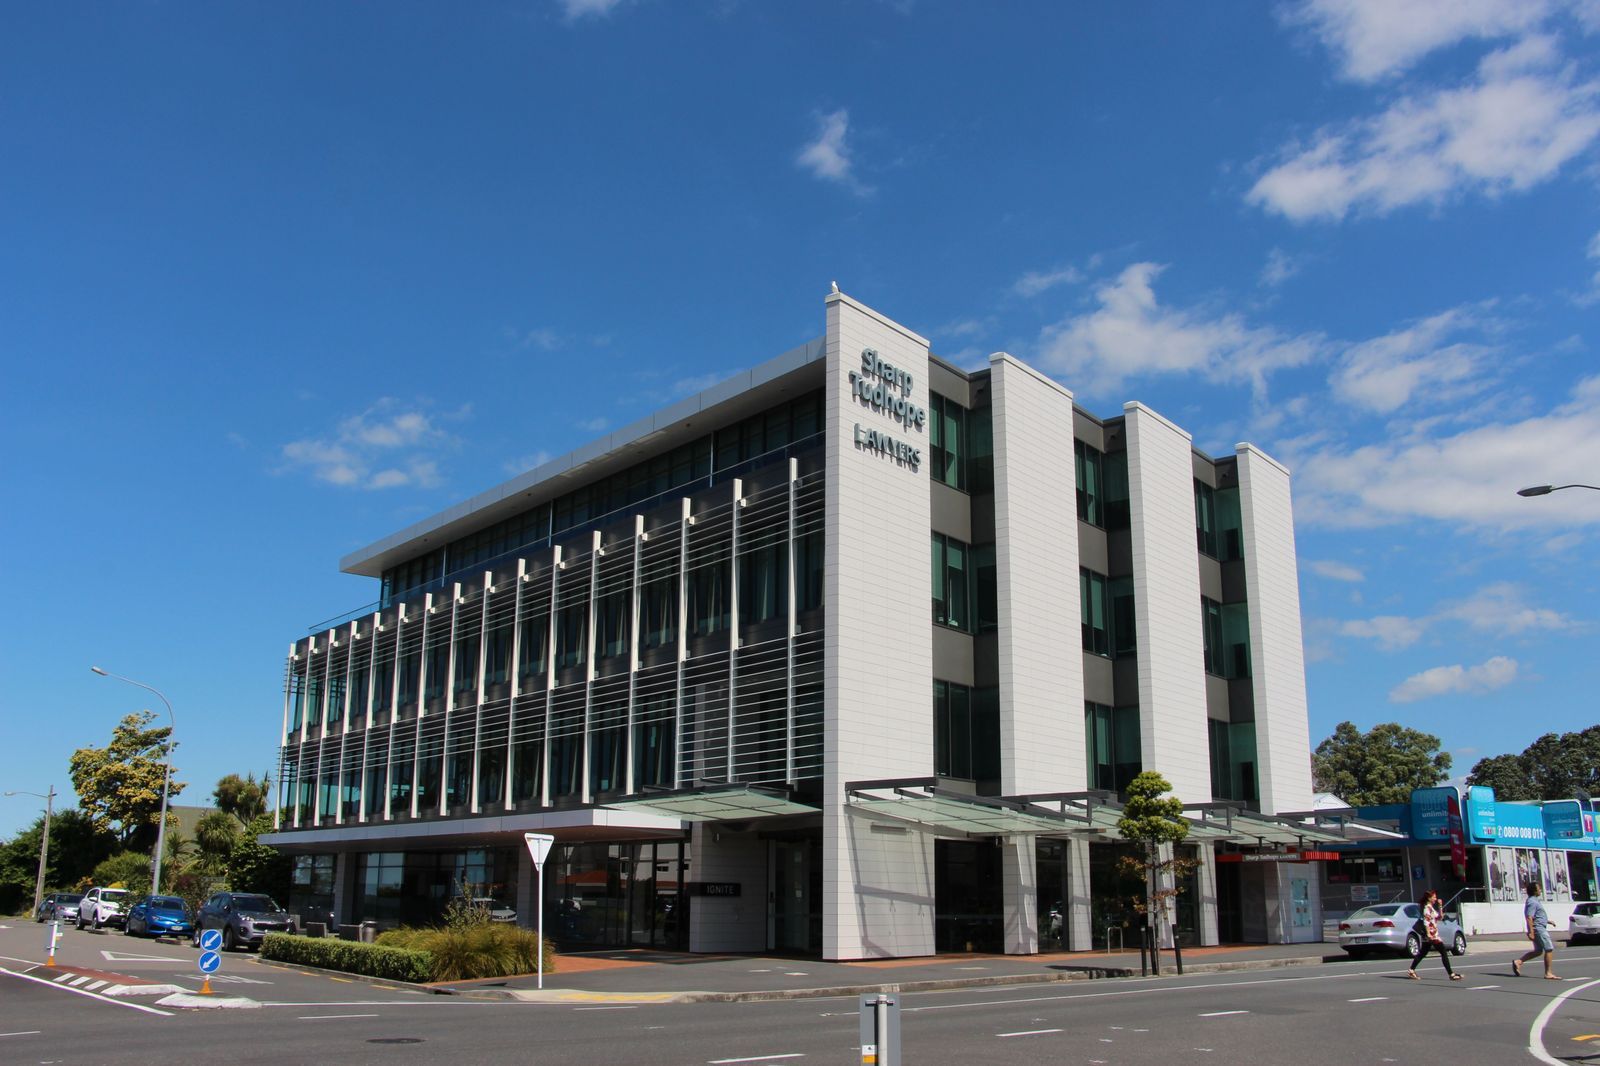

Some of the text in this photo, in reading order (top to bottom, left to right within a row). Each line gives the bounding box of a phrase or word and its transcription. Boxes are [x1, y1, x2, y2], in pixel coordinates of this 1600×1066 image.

[861, 348, 913, 397] Sharp
[849, 370, 926, 428] Tudhope
[854, 423, 921, 466] LAWYERS
[1503, 826, 1519, 838] 0800
[1520, 827, 1532, 839] 008
[707, 884, 735, 895] IGNITE
